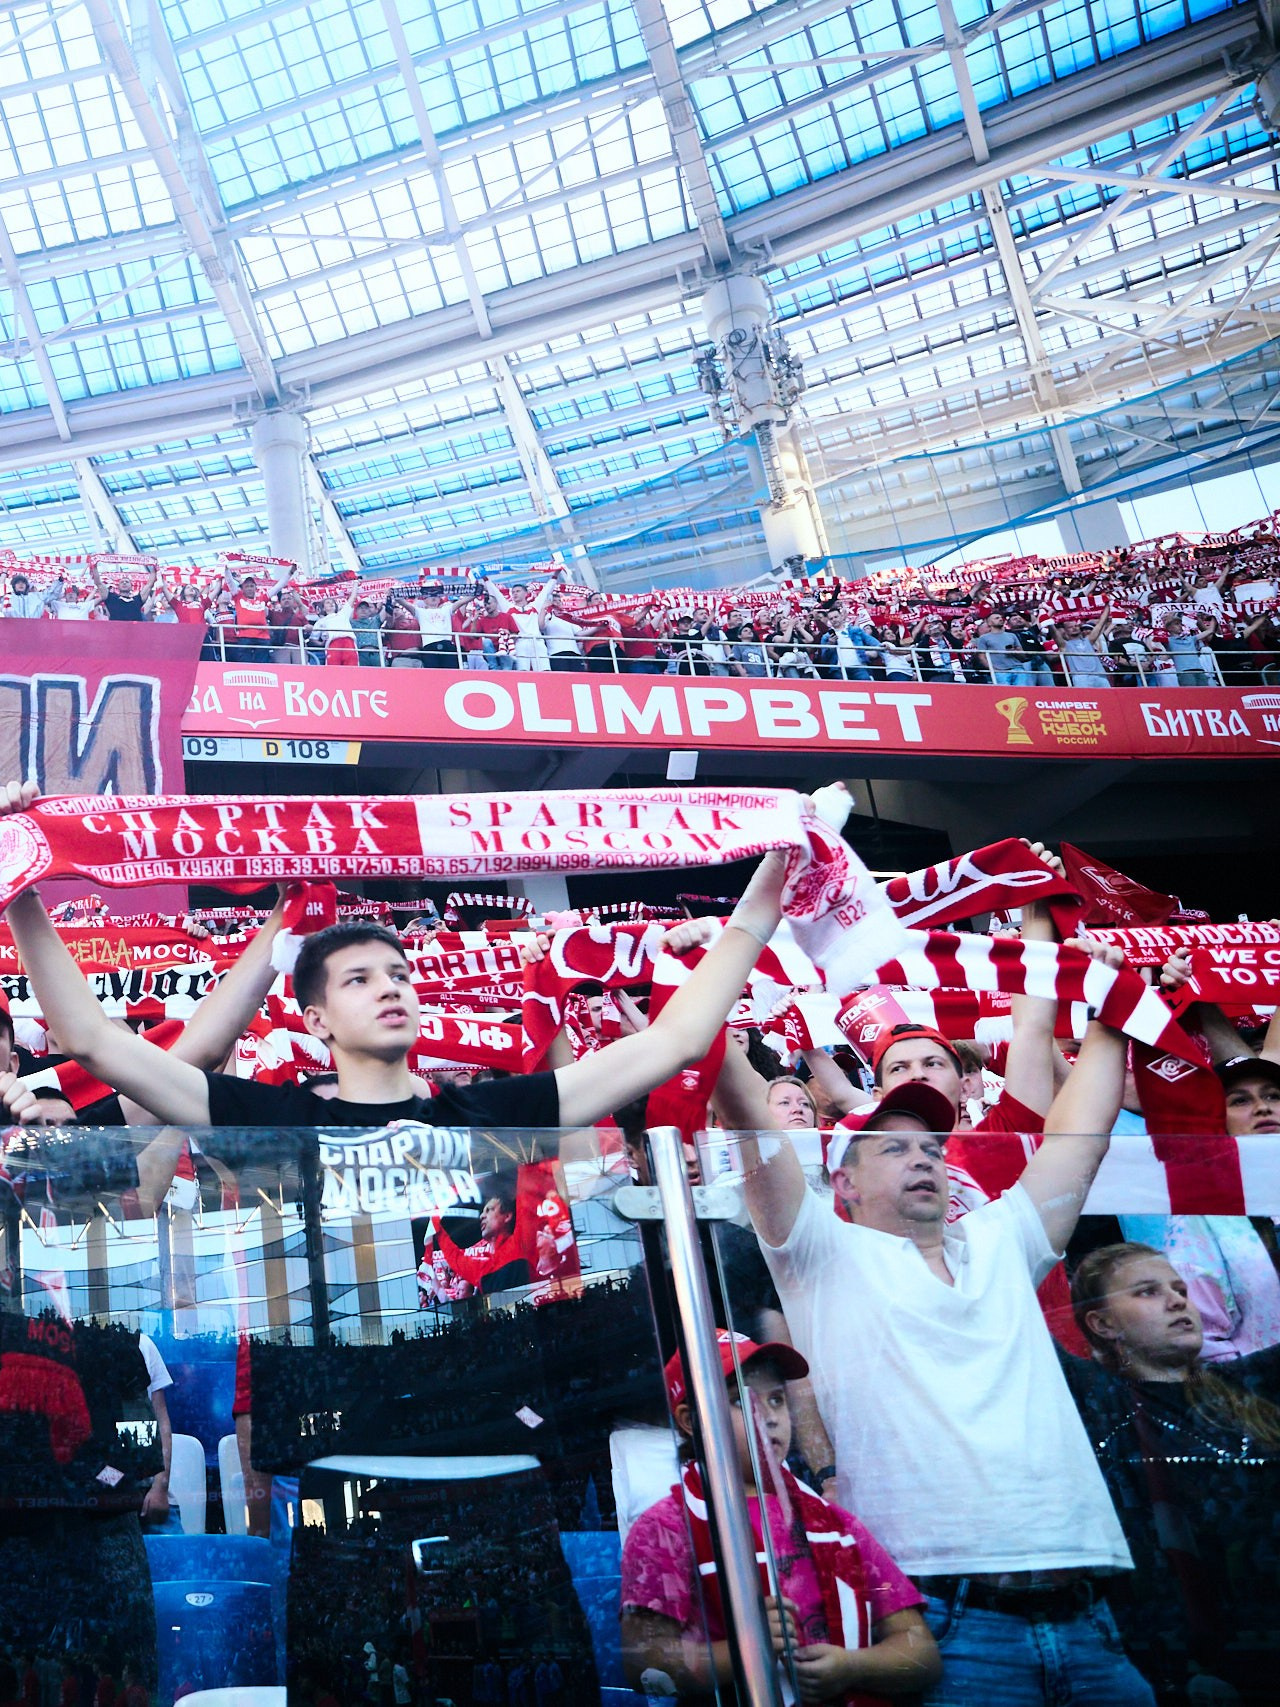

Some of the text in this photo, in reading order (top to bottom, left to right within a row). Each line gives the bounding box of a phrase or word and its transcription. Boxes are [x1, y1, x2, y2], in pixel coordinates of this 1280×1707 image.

[443, 584, 477, 595] ULTRAS
[444, 680, 932, 742] OLIMPBET
[1035, 700, 1098, 710] OLIMPBET
[1038, 710, 1102, 723] СУПЕР
[1042, 722, 1108, 736] КУБОК
[265, 740, 330, 759] D 108
[1056, 736, 1098, 745] РОССИИ
[40, 796, 119, 816] ЧЕМПИОН
[82, 801, 388, 835] СПАРТАК
[449, 801, 742, 831] SPARTAK
[118, 829, 384, 862] МОСКВА
[471, 829, 727, 854] MOSCOW
[180, 858, 234, 877] КУБКА
[833, 899, 868, 929] 1922
[1208, 950, 1258, 965] WE
[1210, 967, 1257, 985] TO
[479, 995, 499, 1004] OVER
[322, 1167, 482, 1214] МОСКВА
[194, 1594, 207, 1604] 27
